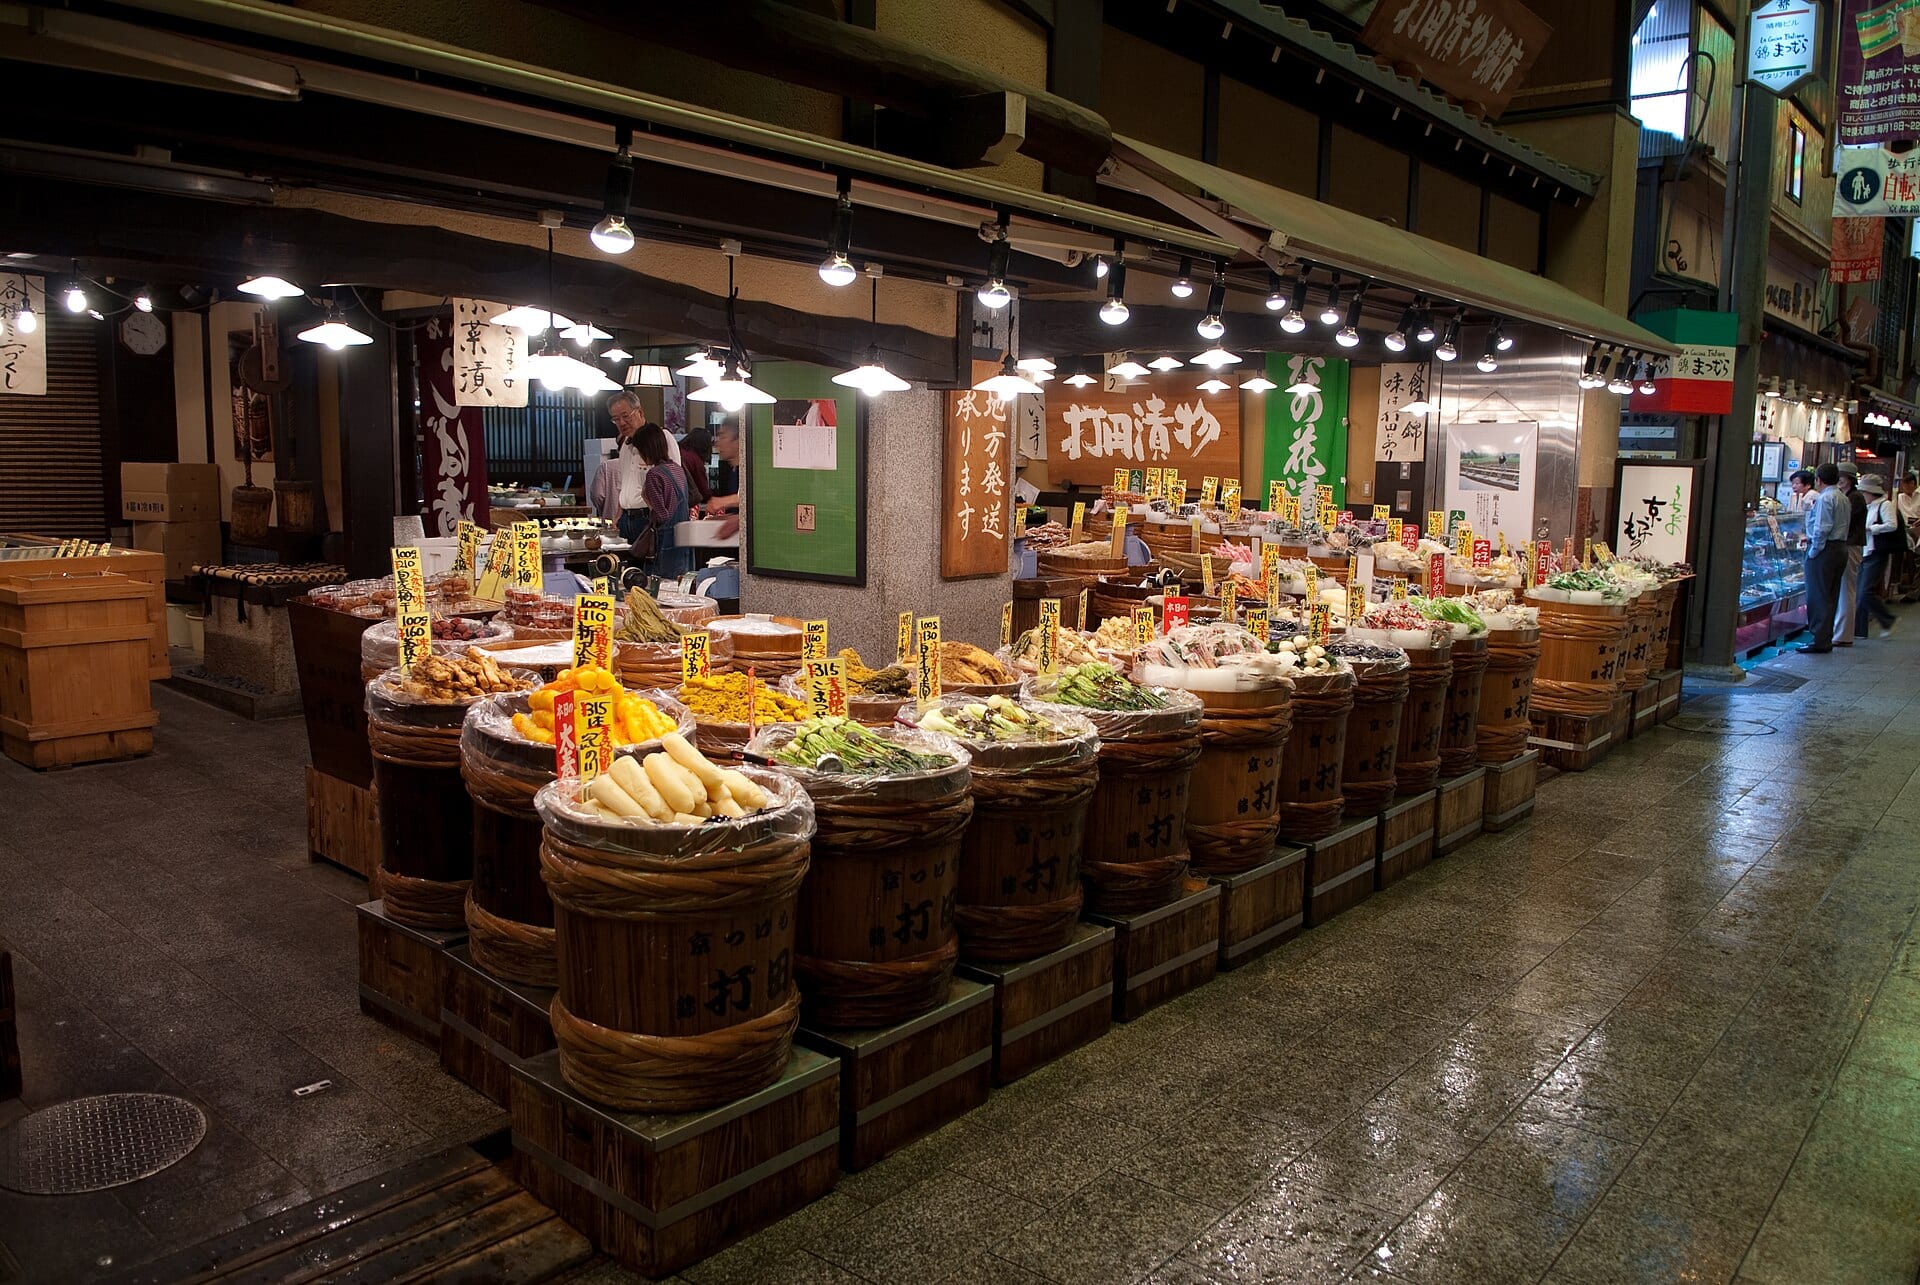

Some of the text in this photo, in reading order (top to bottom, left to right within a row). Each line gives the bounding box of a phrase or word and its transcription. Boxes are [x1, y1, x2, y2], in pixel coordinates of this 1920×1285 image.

[1773, 38, 1808, 57] まつむら
[1760, 70, 1800, 80] イタリア料理
[1888, 157, 1920, 169] 歩行
[1883, 172, 1920, 202] 自転
[1692, 357, 1730, 377] まつむら
[1060, 397, 1222, 461] 打田漬物
[1282, 355, 1327, 521] なの花漬
[955, 391, 983, 542] 承ります
[982, 393, 1006, 541] 地方発送
[395, 549, 418, 559] 100g
[580, 596, 609, 610] 100g
[1166, 602, 1187, 612] 本日の
[402, 616, 428, 627] 100g
[576, 606, 606, 622] ¥110
[399, 627, 425, 640] ¥160
[683, 635, 707, 651] ¥367
[807, 663, 840, 678] ¥315
[580, 701, 611, 717] ¥315
